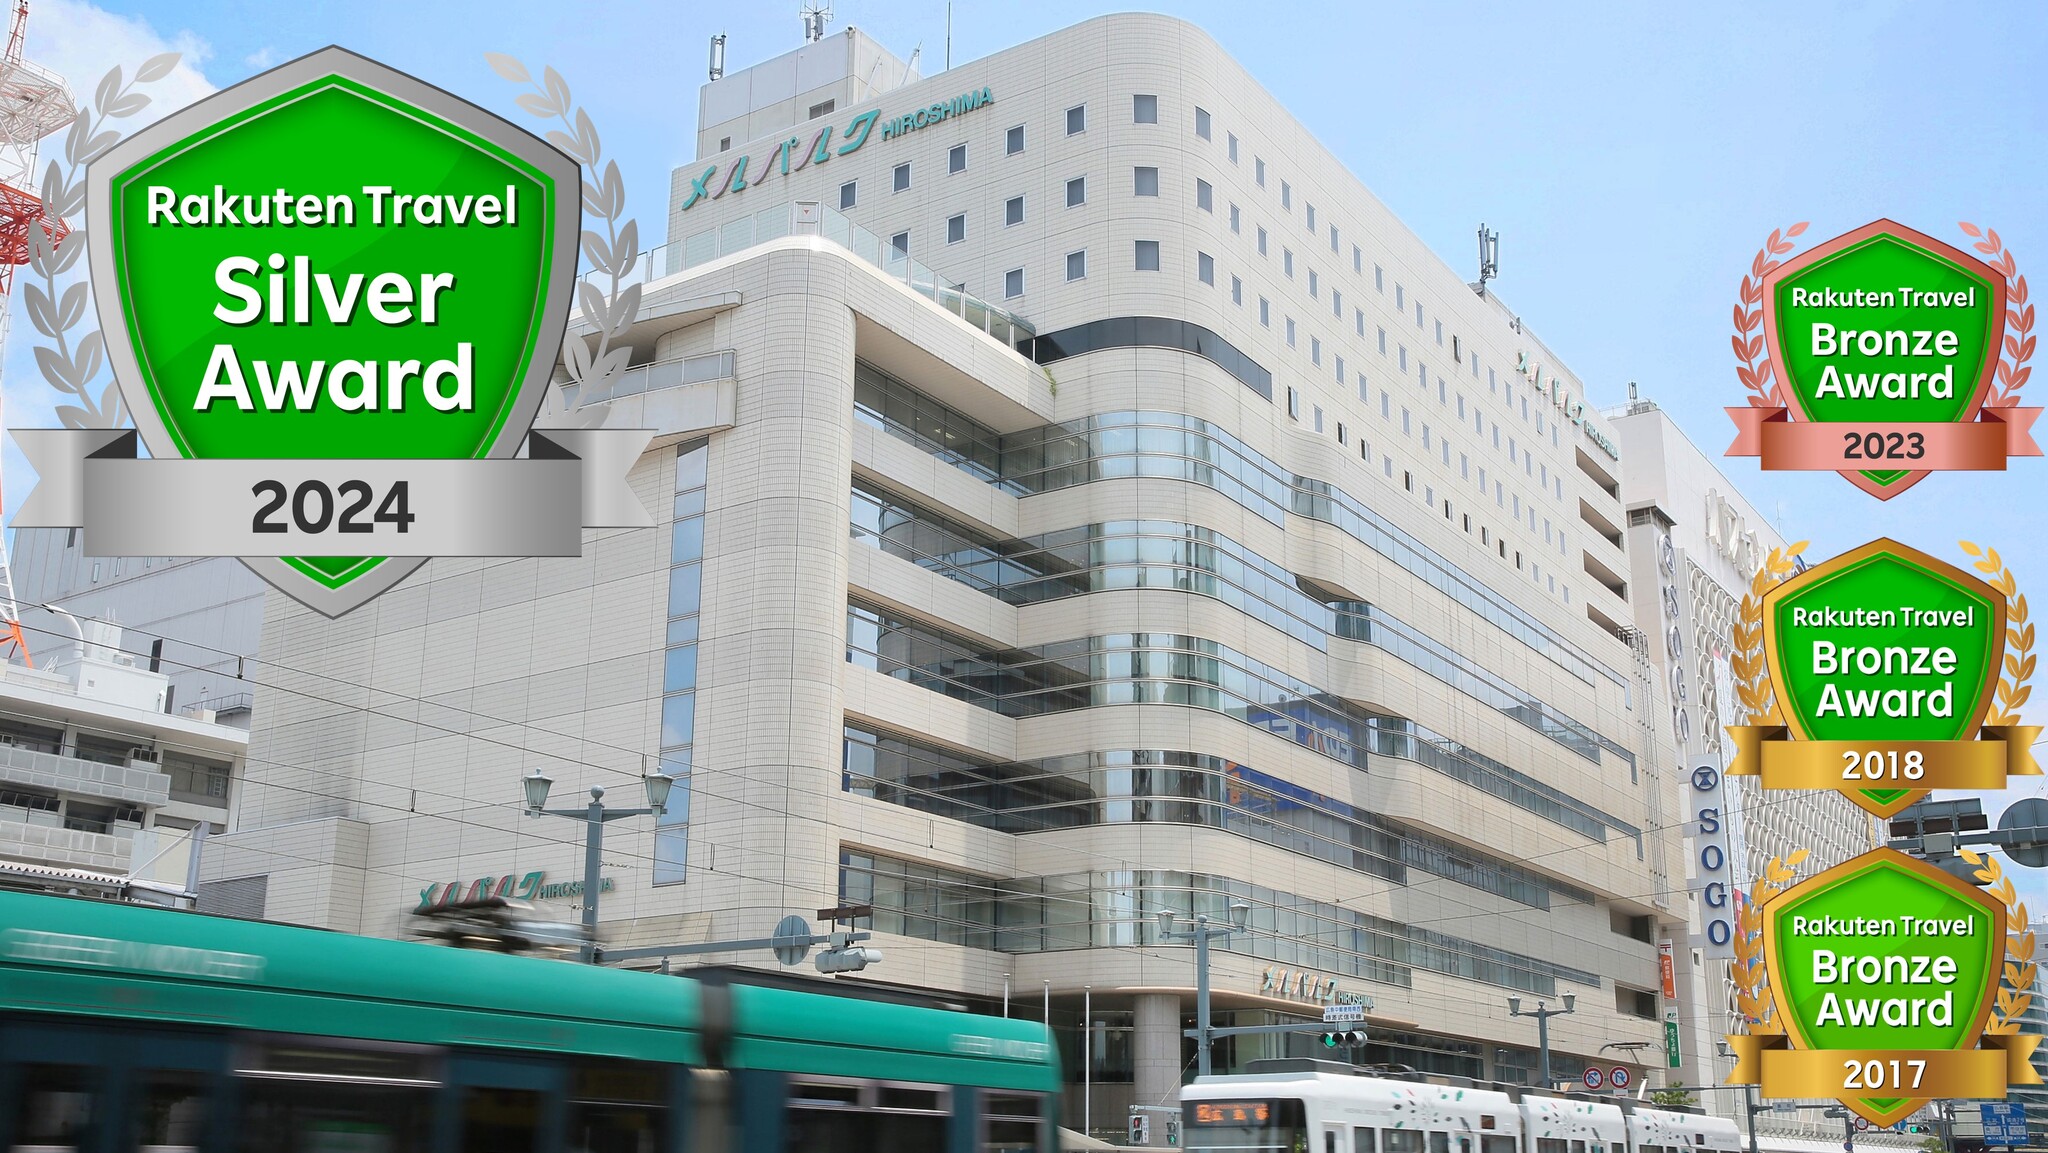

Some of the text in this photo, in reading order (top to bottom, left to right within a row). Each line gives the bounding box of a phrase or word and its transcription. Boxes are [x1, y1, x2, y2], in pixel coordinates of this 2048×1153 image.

[682, 86, 995, 211] メルパルク HIROSHIMA
[1699, 807, 1731, 946] SOGO
